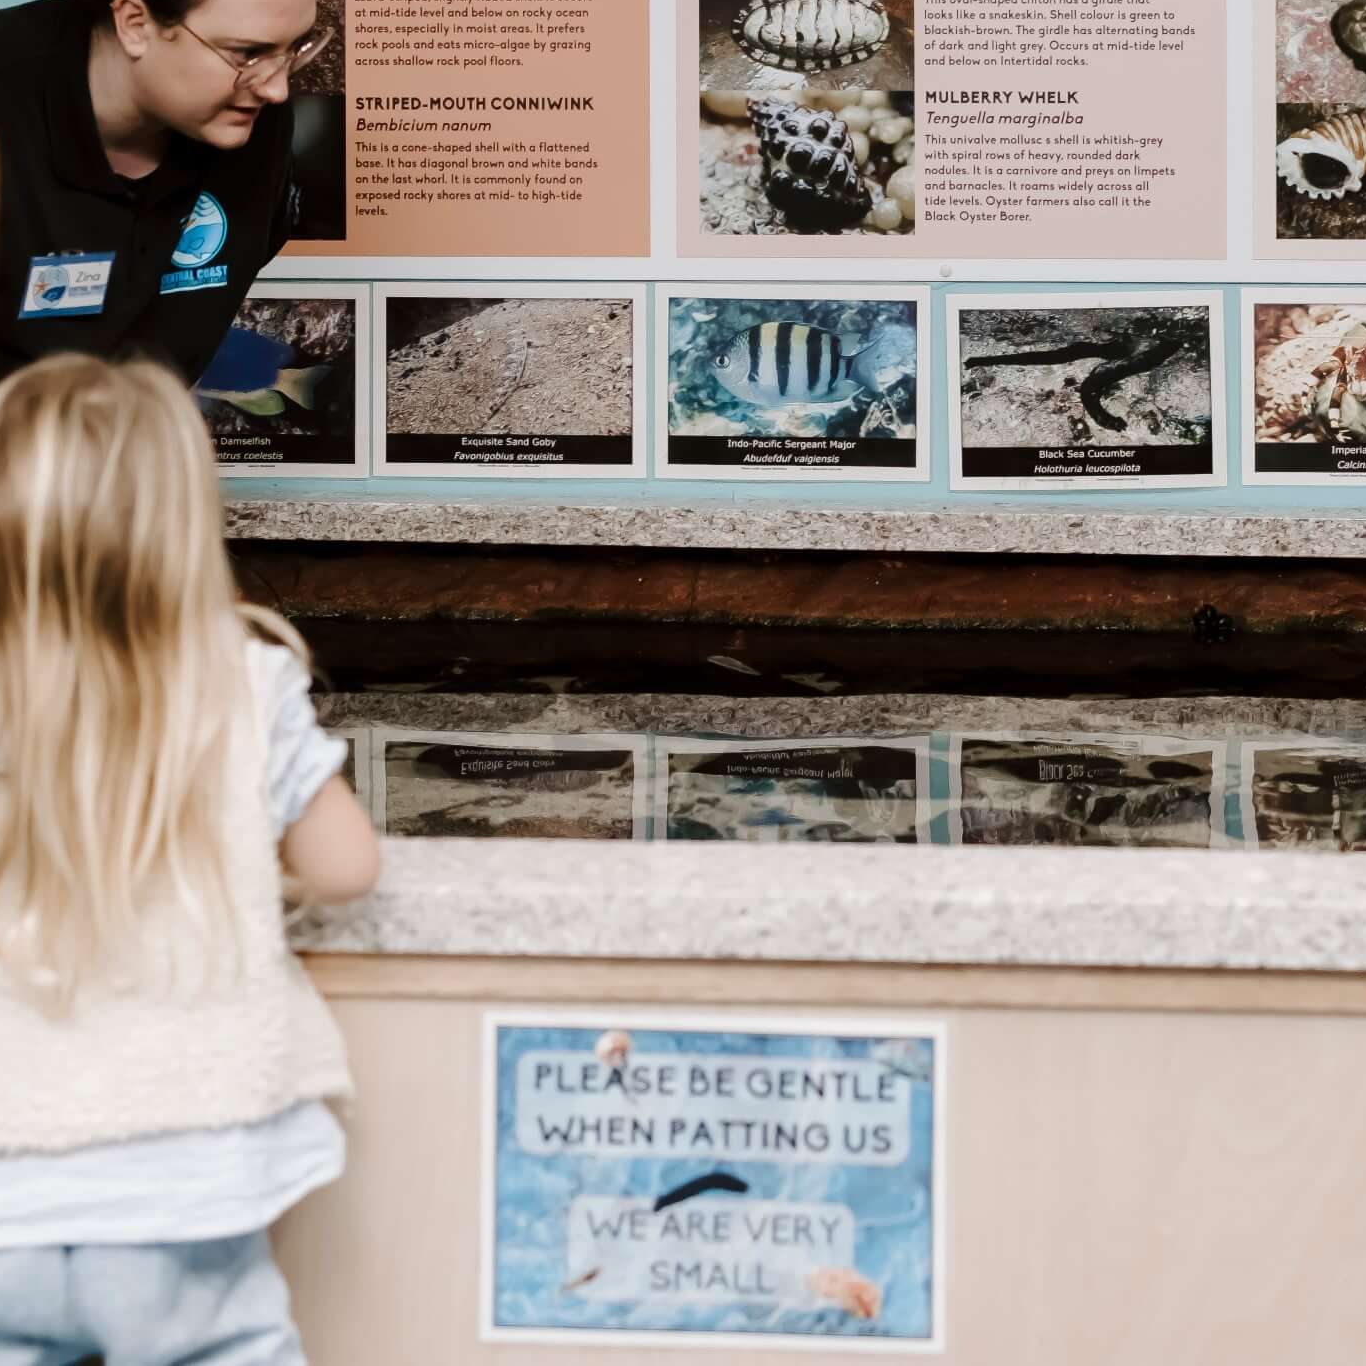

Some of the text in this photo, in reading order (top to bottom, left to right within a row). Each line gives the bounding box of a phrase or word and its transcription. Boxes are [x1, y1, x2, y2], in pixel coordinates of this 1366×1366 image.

[355, 96, 594, 111] STRIPED-MOUTH CONNIWINK
[925, 90, 1079, 104] MULBERRY WHELK
[355, 117, 492, 132] Bembicium nanum
[924, 210, 1033, 225] Black Oyster Borer.
[220, 436, 271, 446] Damselfish
[461, 436, 557, 448] Exquisite Sand Goby
[727, 438, 857, 451] Indo-Pacific Sergeant Major
[243, 451, 284, 460] coelestis
[453, 451, 564, 463] Favonigobius exquisitus
[743, 453, 840, 465] Abudefduf vaigiensis
[1038, 449, 1136, 459] Black Sea Cucumber
[1033, 463, 1141, 475] Holothuria leucospilota
[534, 1062, 897, 1104] PLEASE BE GENTLE
[536, 1116, 892, 1155] WHEN PATTING US
[586, 1211, 841, 1247] WE ARE VERY
[649, 1260, 777, 1296] SMALL
